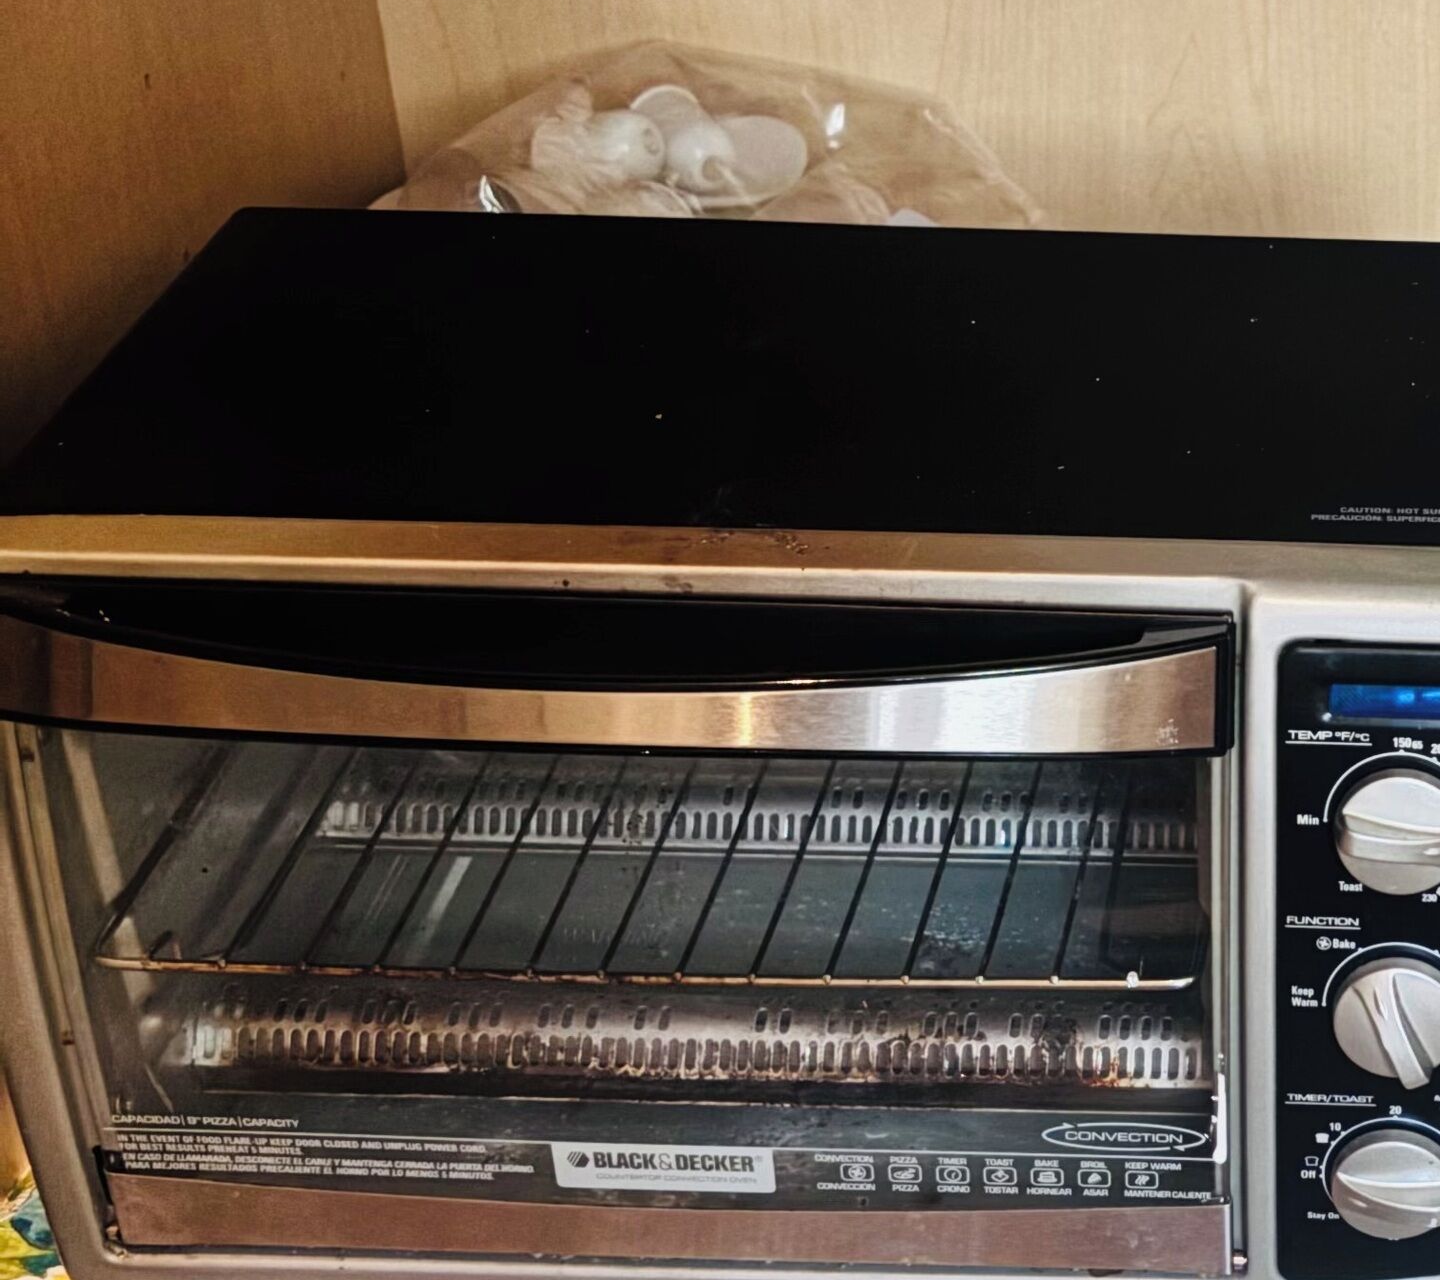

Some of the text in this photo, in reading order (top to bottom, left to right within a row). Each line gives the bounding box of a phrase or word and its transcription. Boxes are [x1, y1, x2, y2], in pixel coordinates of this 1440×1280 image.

[1396, 507, 1419, 515] HOT
[1288, 730, 1333, 740] TEMP
[1393, 737, 1412, 748] 150
[1412, 740, 1423, 749] 65
[1296, 814, 1320, 825] Min
[1338, 881, 1363, 892] Toast
[1422, 894, 1438, 902] 230
[1286, 915, 1360, 926] FUNCTION
[1332, 938, 1356, 949] Bake
[1291, 986, 1315, 997] Keep
[1291, 997, 1318, 1007] Warm
[1286, 1093, 1375, 1103] TIMER/TOAST
[1389, 1105, 1402, 1115] 20
[111, 1114, 182, 1125] CAPACIDAD
[202, 1116, 237, 1127] PIZZA
[242, 1118, 300, 1128] CAPACITY
[1329, 1122, 1341, 1131] 10
[1064, 1130, 1183, 1144] CONVECTION
[323, 1139, 359, 1149] CLOSED
[360, 1140, 382, 1150] AND
[814, 1154, 874, 1163] CONVECTION
[890, 1156, 918, 1164] PIZZA
[937, 1157, 967, 1165] TIMER
[985, 1158, 1014, 1166] TOAST
[1034, 1159, 1059, 1168] BAKE
[1080, 1160, 1107, 1169] BROIL
[1124, 1161, 1182, 1171] KEEP WARM
[1300, 1170, 1316, 1179] Off
[892, 1184, 919, 1192] PIZZA
[937, 1185, 970, 1193] CRONO
[984, 1186, 1019, 1194] TOSTAR
[1026, 1187, 1072, 1196] HORNEAR
[1083, 1189, 1109, 1197] ASAR
[1124, 1190, 1212, 1200] MANTENER CALIENTE
[1307, 1211, 1340, 1220] Stay On
